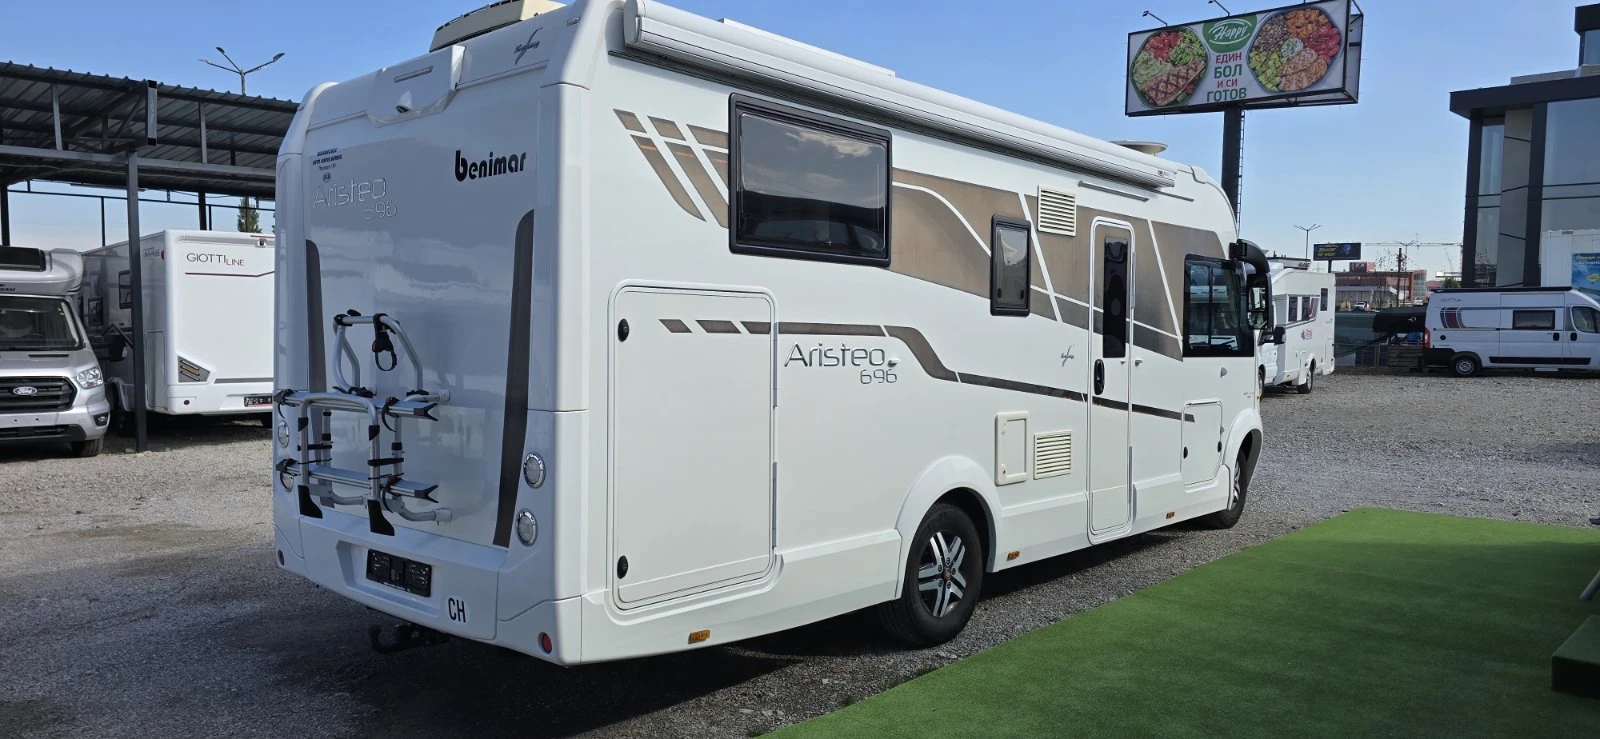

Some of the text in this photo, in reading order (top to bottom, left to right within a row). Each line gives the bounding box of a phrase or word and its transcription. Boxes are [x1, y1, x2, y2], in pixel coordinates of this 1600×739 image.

[1212, 25, 1248, 40] Happy
[1215, 52, 1242, 64] ЕДИН
[1214, 63, 1242, 79] БОЛ
[1217, 78, 1238, 88] И СИ
[1206, 87, 1247, 103] ГОТОВ
[454, 149, 527, 182] benimar
[313, 178, 387, 209] Aristeo
[784, 342, 886, 368] Aristeo
[859, 368, 898, 385] 696
[447, 597, 467, 623] CH
